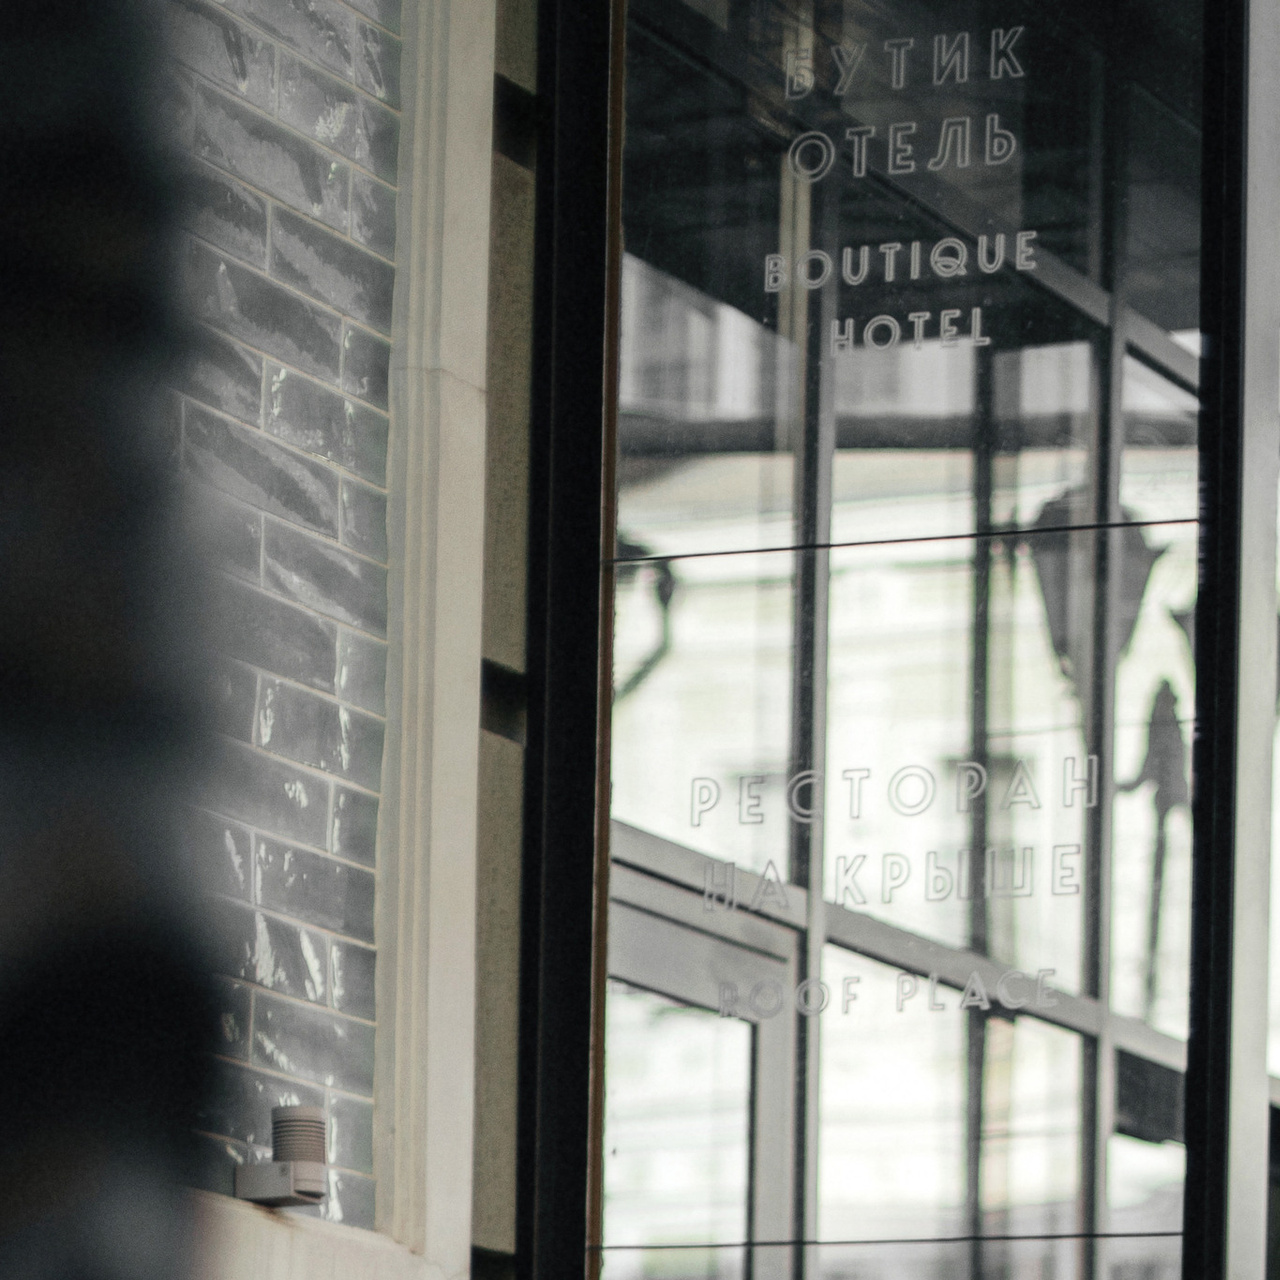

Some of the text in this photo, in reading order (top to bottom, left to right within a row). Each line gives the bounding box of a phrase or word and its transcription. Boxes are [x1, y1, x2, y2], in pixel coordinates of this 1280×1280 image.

[785, 26, 1025, 100] БУТИК
[788, 113, 1017, 183] ОТЕЛЬ
[764, 230, 1038, 293] BOUTIQUE
[830, 307, 991, 357] HOTEL
[690, 754, 1099, 827] РЕСТОРАН
[702, 843, 1081, 912] НА КРЫШЕ
